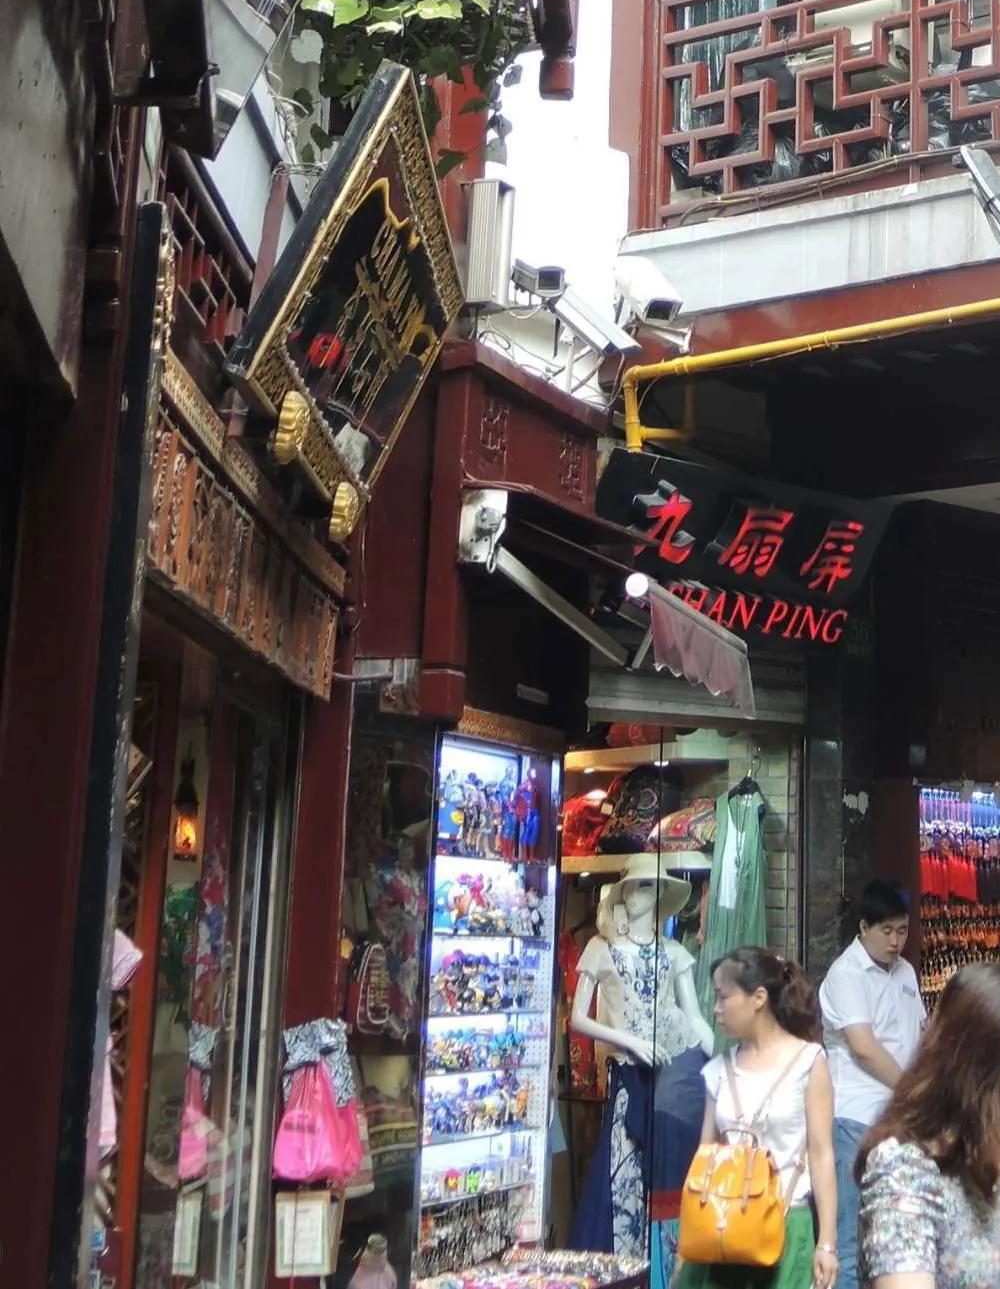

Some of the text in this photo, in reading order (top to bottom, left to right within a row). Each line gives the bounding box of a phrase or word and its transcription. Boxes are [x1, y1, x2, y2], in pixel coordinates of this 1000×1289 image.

[633, 480, 864, 595] 九扇屏
[762, 598, 848, 645] PING
